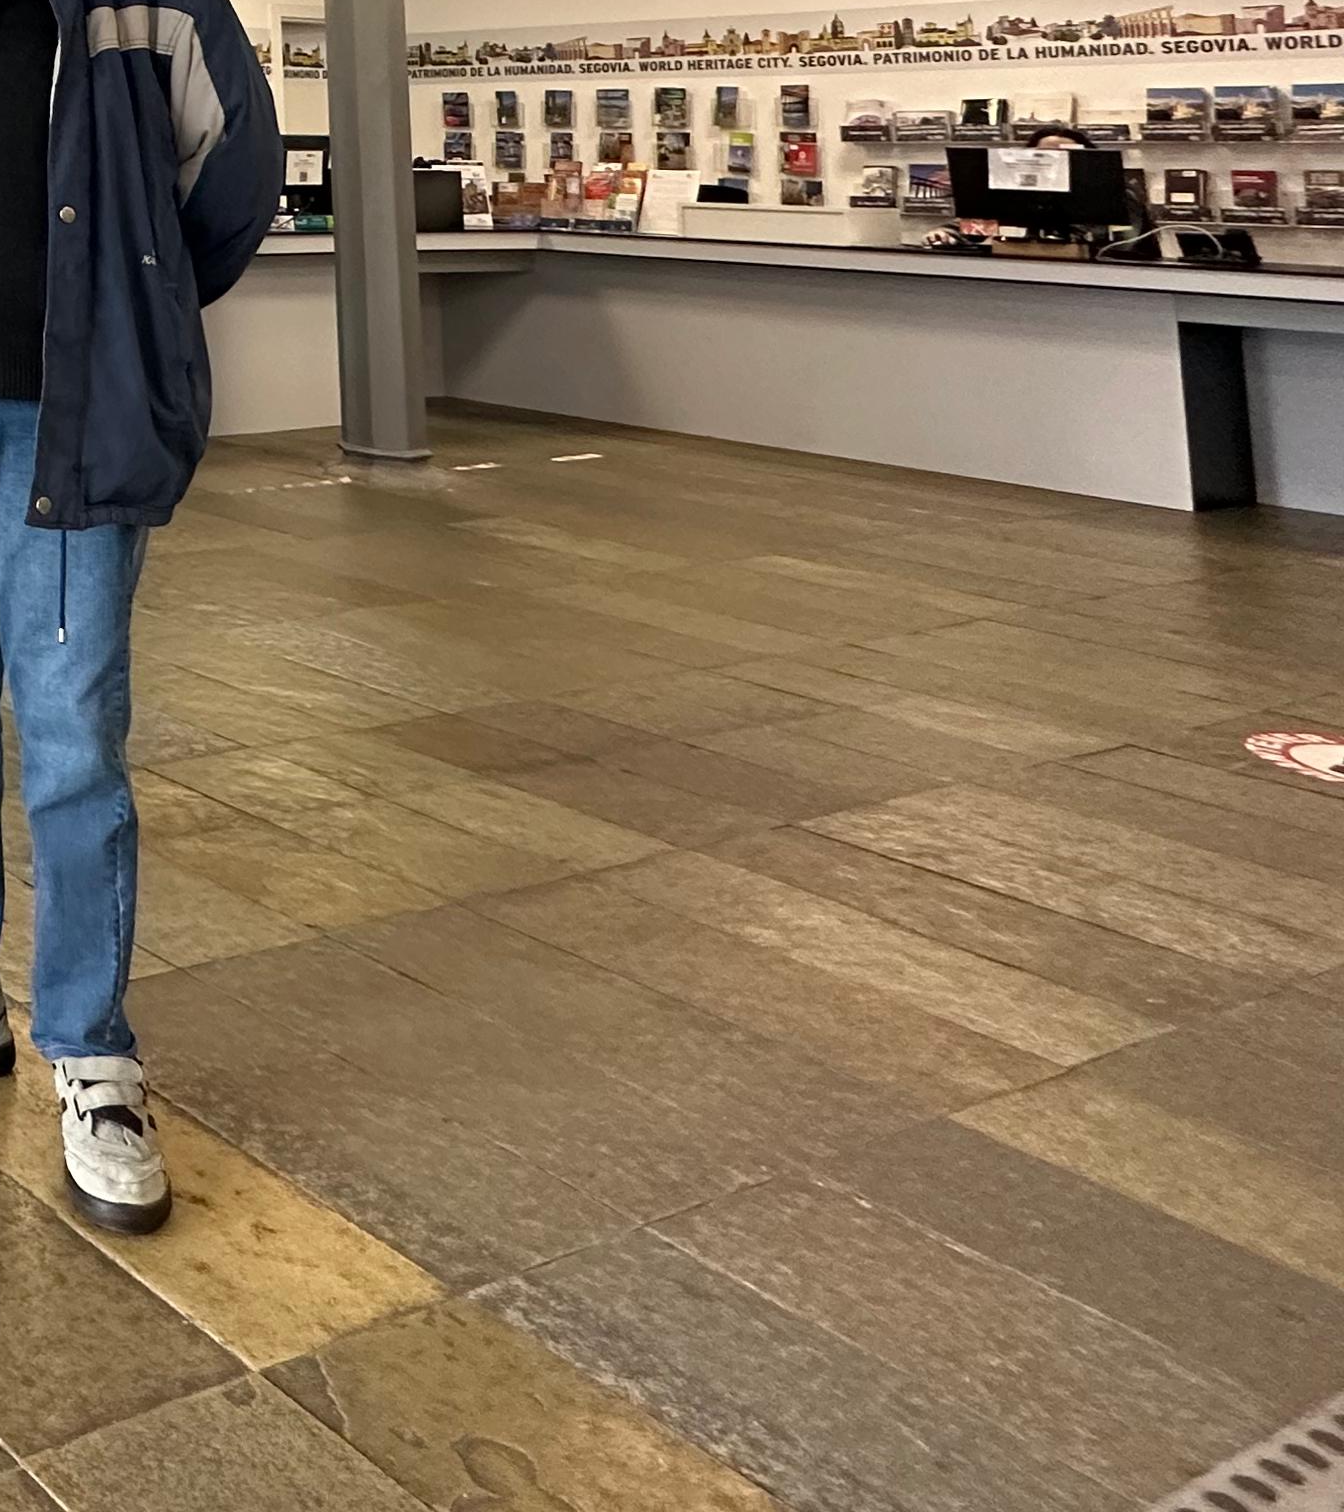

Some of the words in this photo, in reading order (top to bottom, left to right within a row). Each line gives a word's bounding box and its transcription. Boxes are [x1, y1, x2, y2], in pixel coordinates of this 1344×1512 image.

[470, 66, 484, 77] DE
[487, 65, 501, 77] LA
[504, 63, 576, 76] HUMANIDAD.
[579, 61, 635, 75] SEGOVIA.
[638, 59, 683, 72] WORLD
[687, 57, 753, 71] HERITAGE
[757, 56, 793, 69] CITY.
[798, 54, 868, 68] SEGOVIA.
[873, 49, 972, 65] PATRIMONIO
[978, 48, 1000, 61] DE
[1006, 47, 1028, 60] LA
[1035, 42, 1155, 60] HUMANIDAD.
[1161, 37, 1258, 55] SEGOVIA.
[1265, 34, 1343, 51] WORLD
